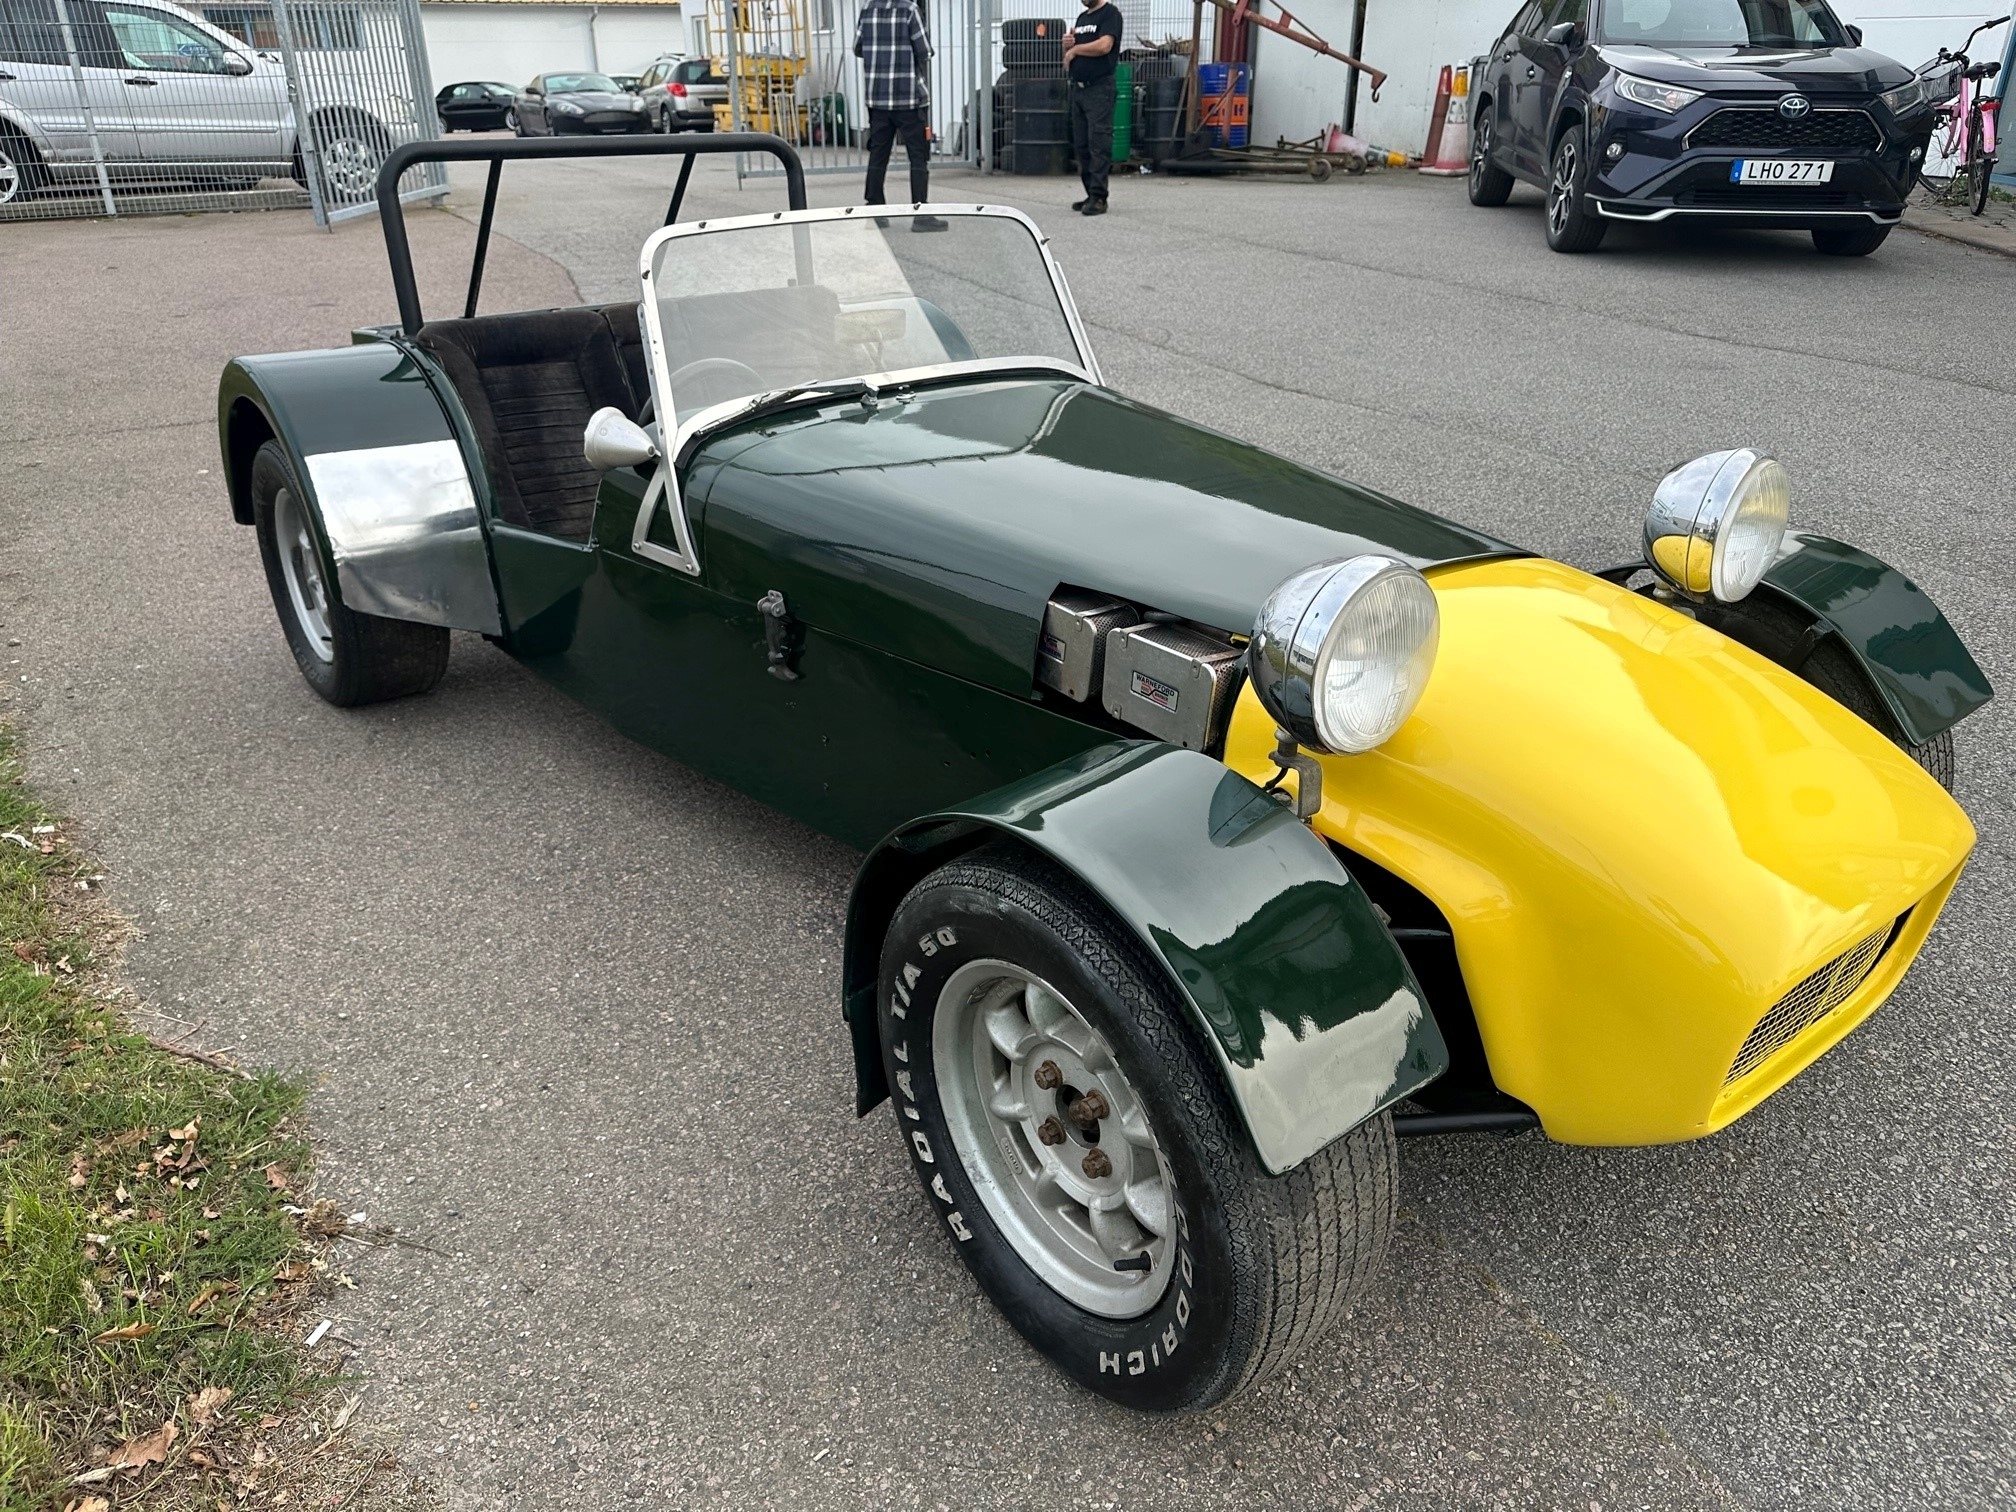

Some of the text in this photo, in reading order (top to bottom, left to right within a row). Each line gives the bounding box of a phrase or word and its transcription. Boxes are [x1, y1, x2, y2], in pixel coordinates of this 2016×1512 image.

[1748, 162, 1825, 180] LHO 271
[1136, 673, 1175, 697] WARNEFORD
[891, 926, 973, 1242] RADIAL T/A 50
